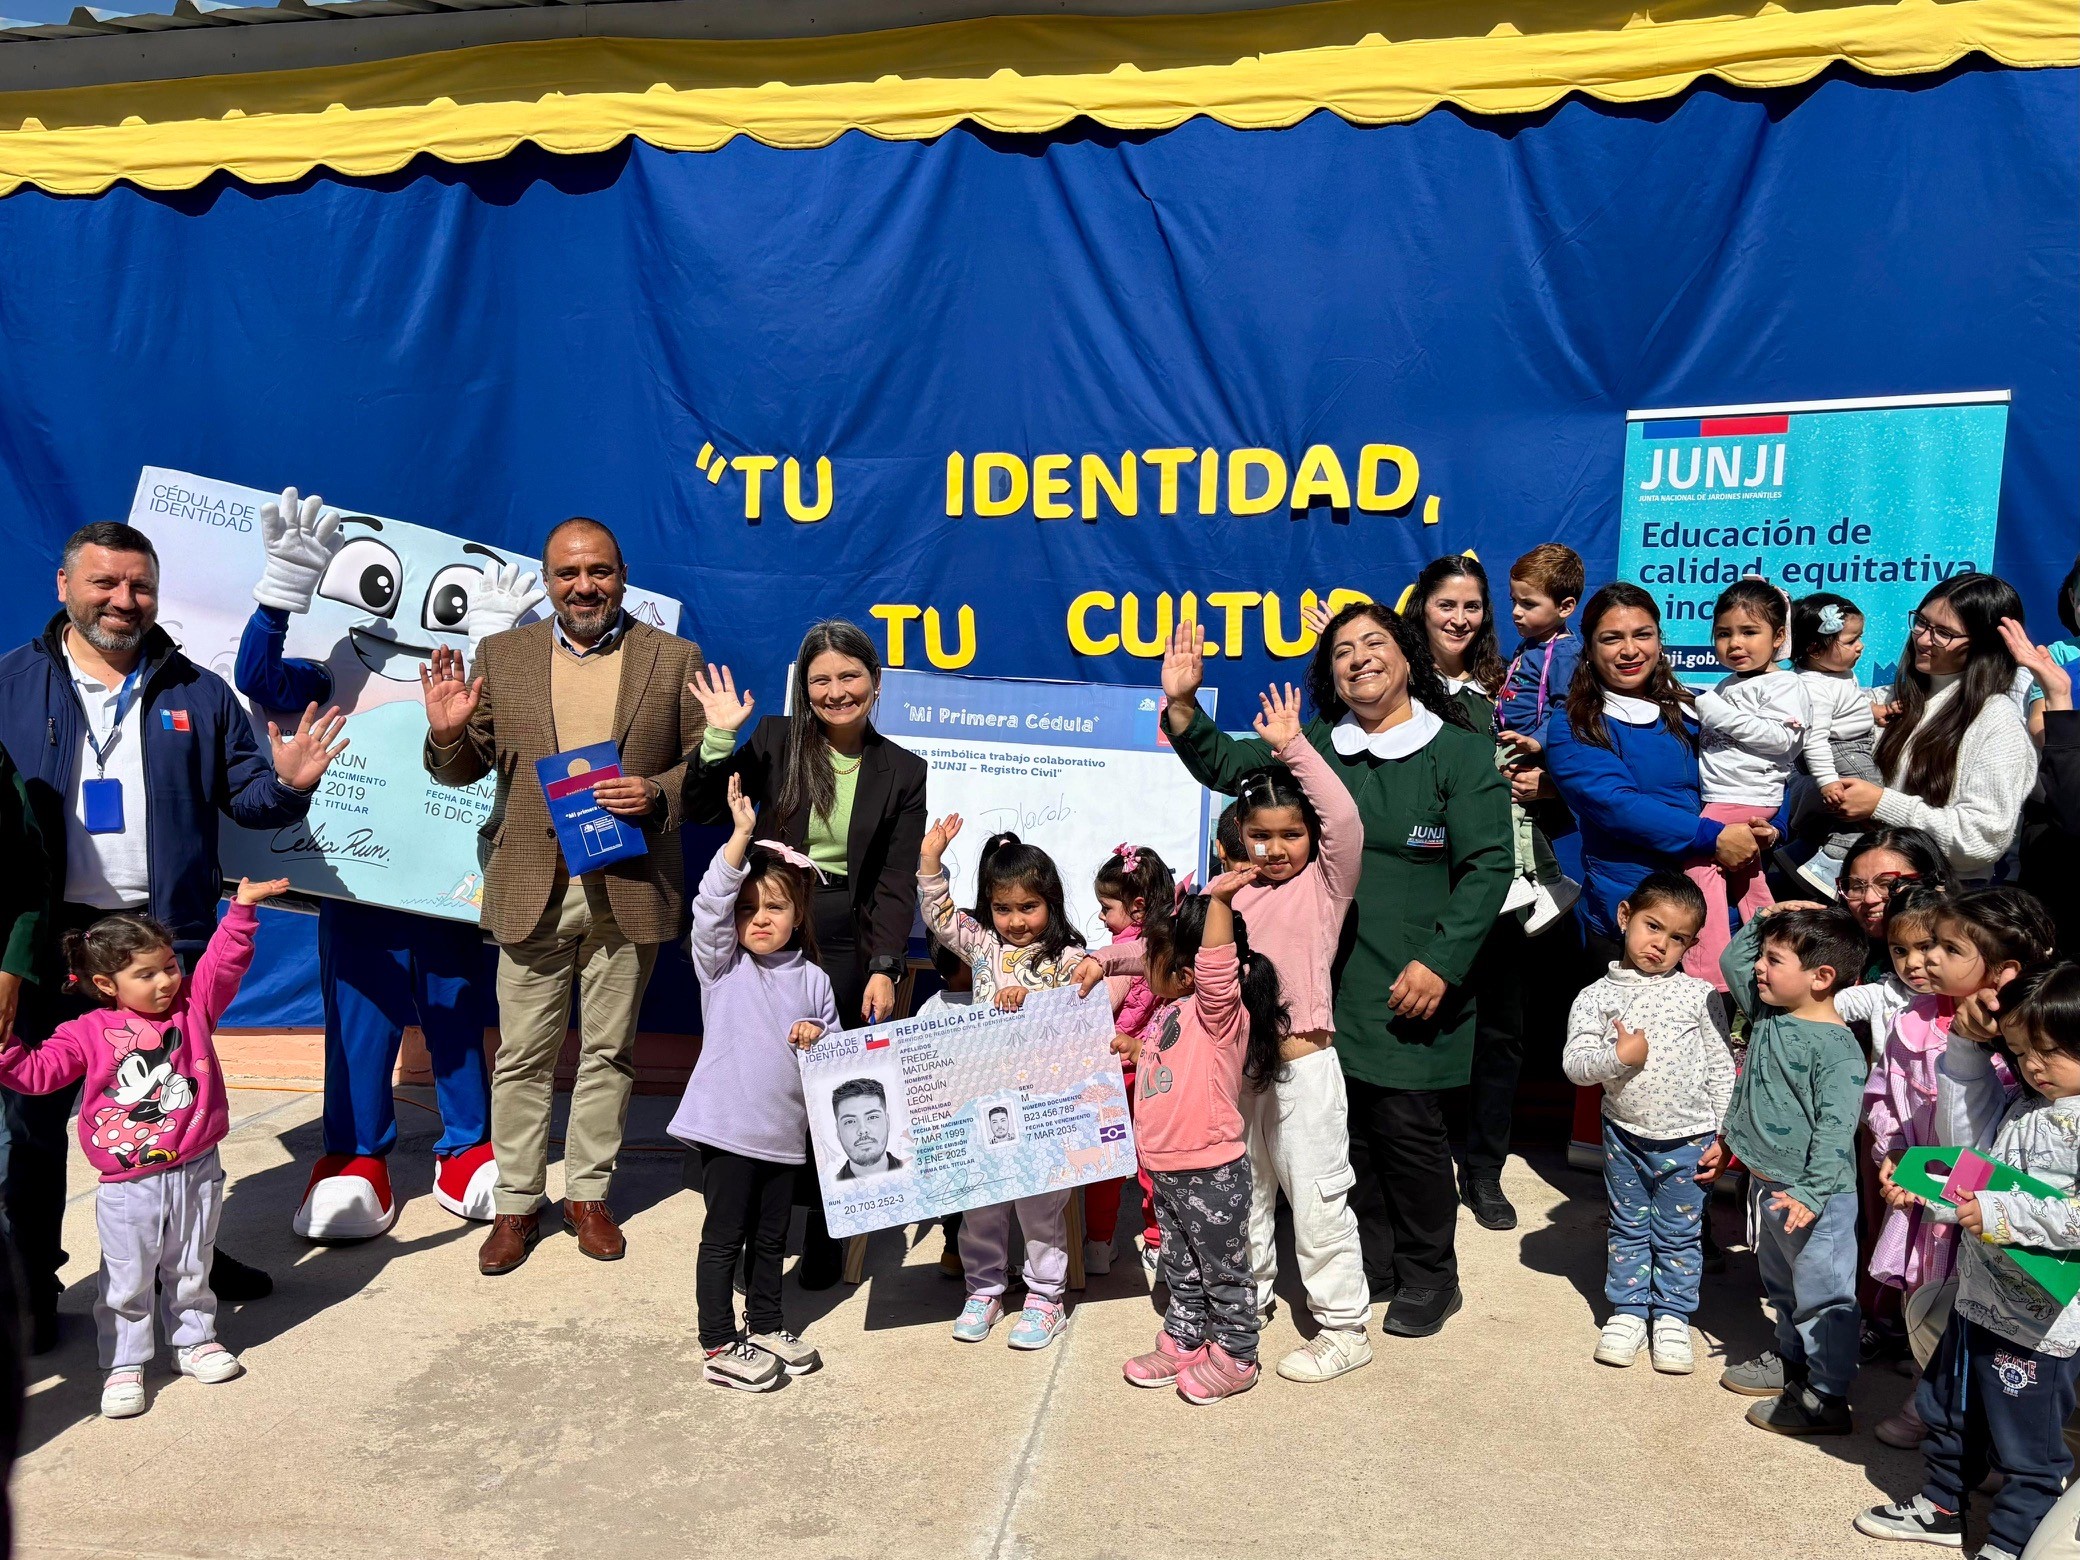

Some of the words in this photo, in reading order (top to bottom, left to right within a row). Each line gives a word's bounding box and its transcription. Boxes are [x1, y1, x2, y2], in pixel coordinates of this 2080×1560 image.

[1640, 444, 1786, 490] JUNJI
[946, 443, 1440, 524] IDENTIDAD,
[153, 484, 226, 513] CÉDULA
[230, 502, 256, 520] DE
[1708, 492, 1741, 500] JARDINES
[1742, 491, 1783, 499] INFANTILES
[149, 498, 253, 533] IDENTIDAD
[1642, 518, 1816, 548] Educación
[1827, 517, 1872, 546] de
[1639, 557, 1770, 584] calidad,
[1782, 553, 1977, 589] equitativa
[868, 604, 977, 670] TU
[1067, 584, 1416, 658] CULTU
[1662, 650, 1720, 669] nji.gob.
[939, 707, 1019, 728] Primera
[931, 748, 986, 760] simbólica
[989, 752, 1031, 764] trabajo
[1033, 755, 1106, 768] colaborativo
[931, 761, 967, 772] JUNJI
[980, 764, 1028, 776] Registro
[325, 768, 387, 787] NACIMIENTO
[325, 781, 366, 801] 2019
[426, 789, 457, 803] FECHA
[460, 798, 473, 807] DE
[325, 799, 369, 815] TITULAR
[424, 801, 441, 816] 16
[444, 805, 473, 824] DIC
[1409, 825, 1446, 839] JUNJI
[895, 1016, 965, 1036] REPÚBLICA
[969, 1010, 985, 1021] DE
[989, 1006, 1024, 1017] CHE
[844, 1037, 858, 1046] DE
[898, 1034, 923, 1044] SERVICIO
[933, 1028, 962, 1037] REGISTRO
[805, 1047, 859, 1063] IDENTIDAD
[900, 1043, 932, 1054] APELLIDOS
[901, 1050, 939, 1065] FREDEZ
[902, 1057, 955, 1076] MATURANA
[904, 1074, 933, 1084] NOMBRES
[906, 1079, 947, 1096] JOAQUÍN
[907, 1093, 933, 1106] LEÓN
[1020, 1093, 1030, 1102] M
[1022, 1101, 1046, 1111] NÚMERO
[1047, 1094, 1082, 1106] DOCUMENTO
[910, 1101, 952, 1114] NACIONALIDAD
[1023, 1104, 1075, 1122] B23.456.789
[911, 1110, 952, 1126] CHILENA
[913, 1126, 931, 1134] FECHA
[940, 1117, 974, 1129] NACIMIENTO
[1025, 1123, 1044, 1131] FECHA
[1055, 1113, 1091, 1125] VENCIMIENTO
[913, 1137, 919, 1145] 7
[921, 1133, 943, 1144] MAR
[944, 1128, 965, 1139] 1999
[1027, 1133, 1032, 1141] 7
[1033, 1130, 1055, 1140] MAR
[1056, 1124, 1077, 1137] 2035
[916, 1146, 934, 1155] FECHA
[944, 1140, 968, 1149] EMISIÓN
[917, 1157, 923, 1166] 3
[924, 1153, 944, 1165] ENE
[945, 1148, 967, 1160] 2025
[920, 1166, 938, 1174] FIRMA
[951, 1158, 975, 1168] TITULAR
[844, 1194, 904, 1215] 20.703.252-3
